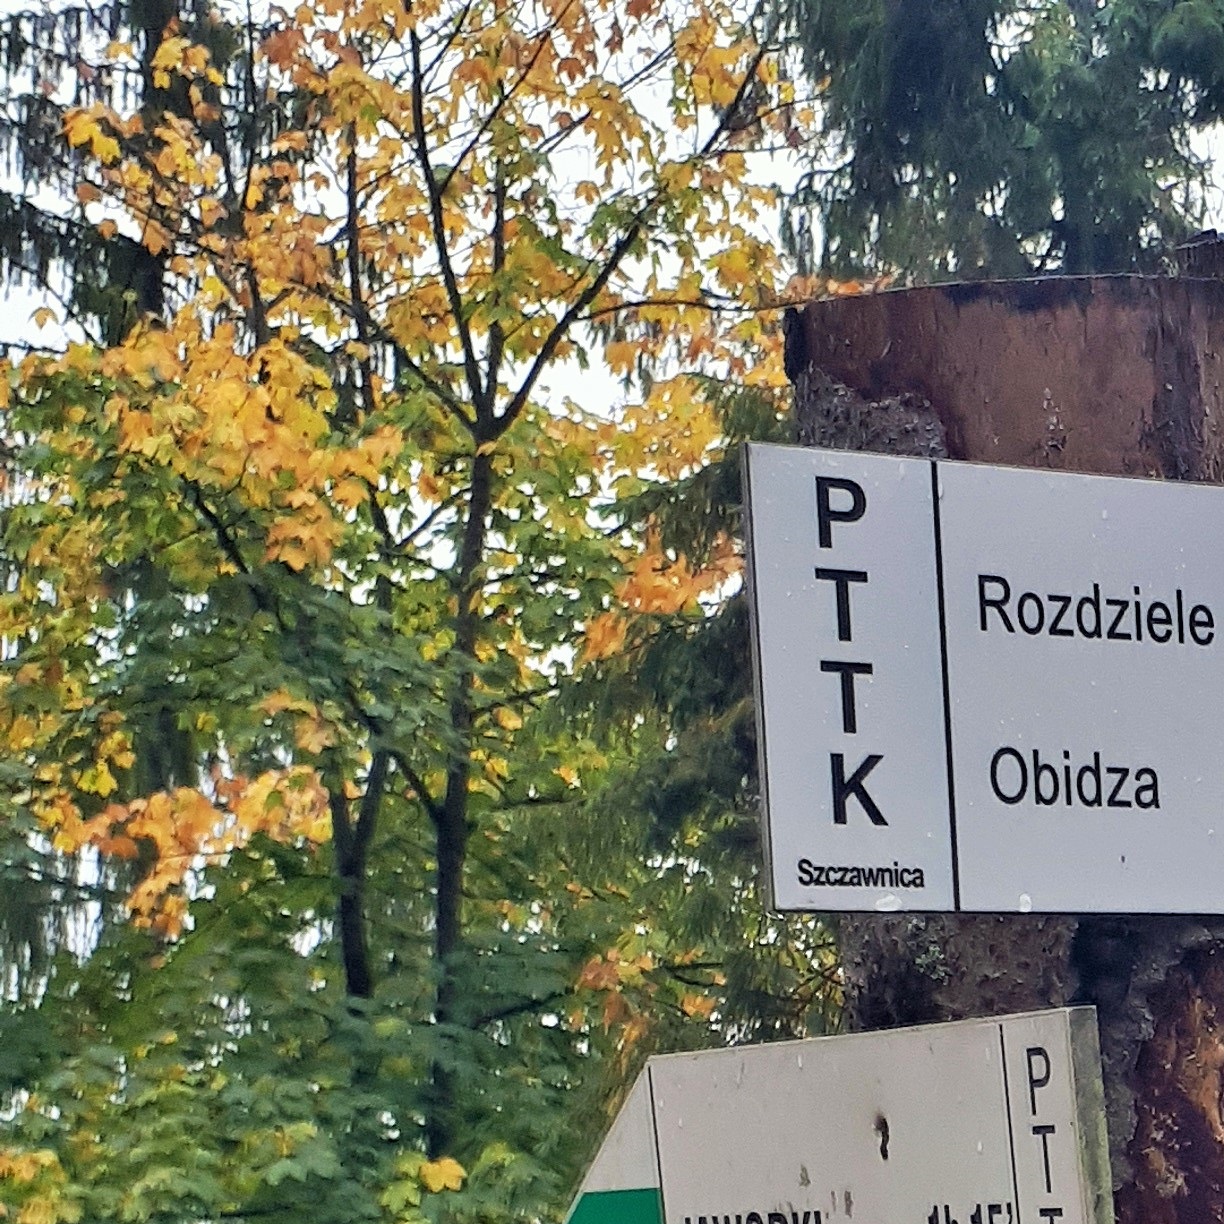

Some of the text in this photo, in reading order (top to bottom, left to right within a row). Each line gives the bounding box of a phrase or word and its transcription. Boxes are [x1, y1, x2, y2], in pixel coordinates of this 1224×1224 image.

[977, 574, 1215, 646] Rozdziele
[814, 475, 889, 827] PTTK
[990, 746, 1161, 810] Obidza
[797, 858, 925, 888] Szczawnica
